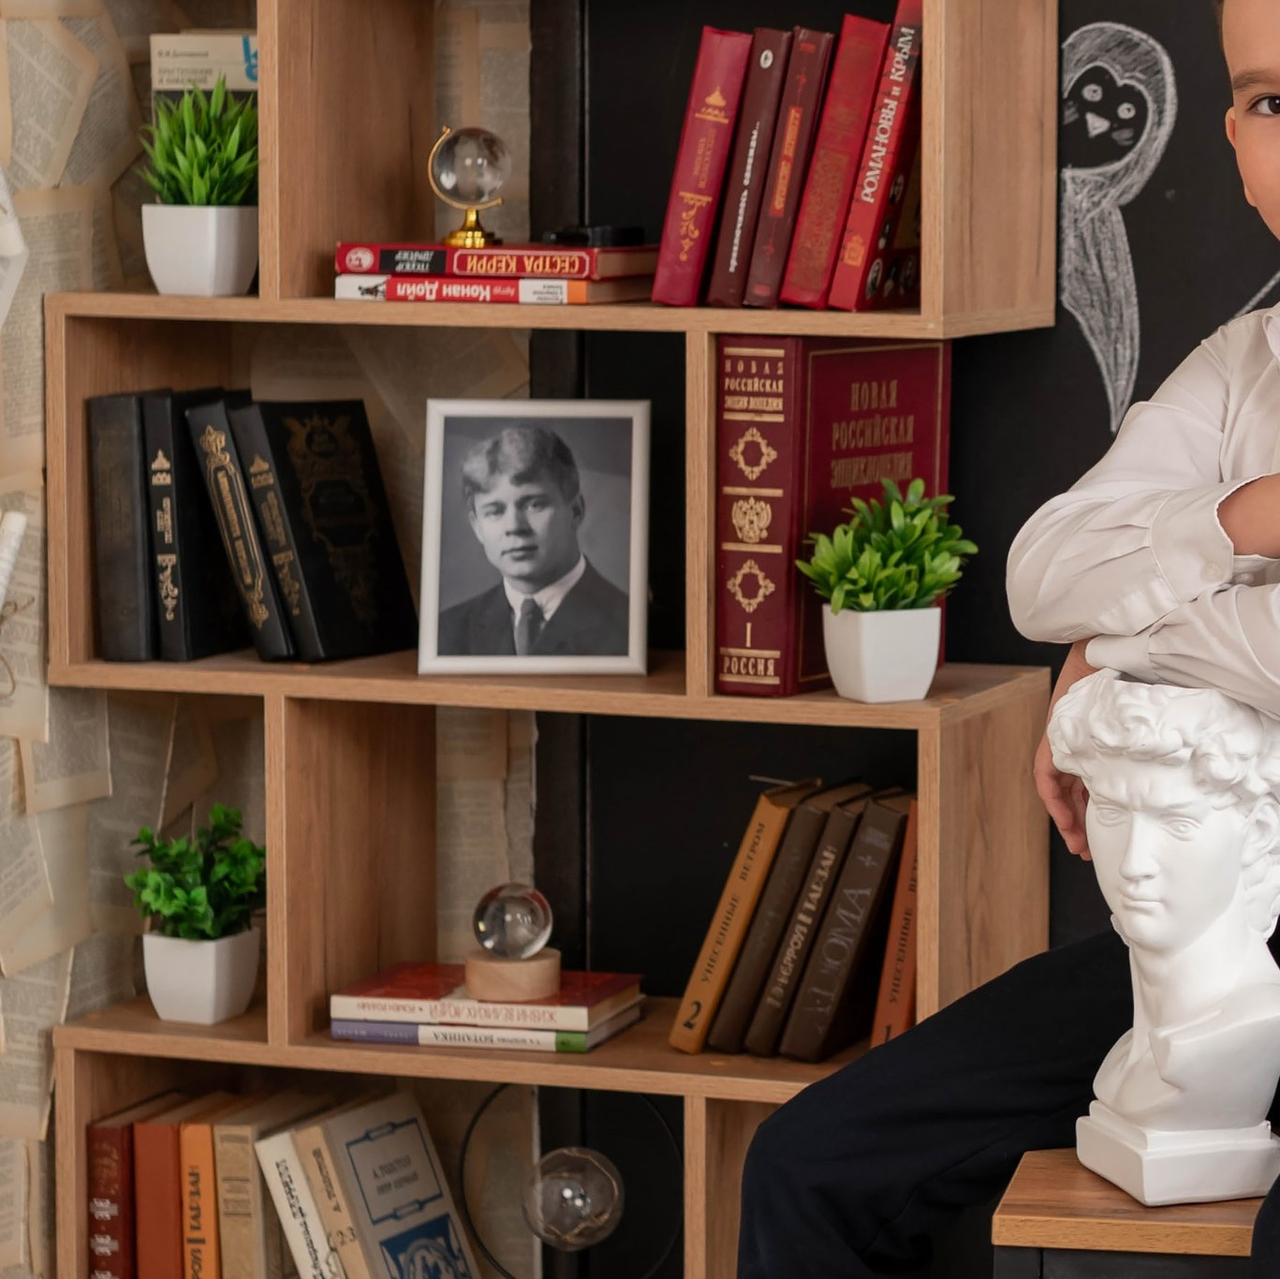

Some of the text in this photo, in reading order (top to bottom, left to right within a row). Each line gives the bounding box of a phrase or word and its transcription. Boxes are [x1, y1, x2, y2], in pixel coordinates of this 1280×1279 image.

[861, 98, 899, 204] РОМАНОВЫ
[890, 26, 916, 82] КРЫМ
[467, 254, 580, 273] СЕСТРА КЕРРИ
[396, 282, 439, 301] Дойл
[442, 283, 492, 302] Конан
[724, 359, 784, 375] НОВАЯ
[724, 377, 784, 394] РОССИЙСКАЯ
[850, 380, 898, 412] НОВАЯ
[831, 415, 915, 451] РОССИЙСКАЯ
[722, 655, 776, 677] РОССИЯ
[702, 821, 766, 984] УНЕСЕННЫЕ ВЕТРОМ
[888, 907, 913, 1003] УНЕСЕННЫЕ
[683, 1000, 703, 1030] 2
[432, 1031, 494, 1045] БОТАНИКА
